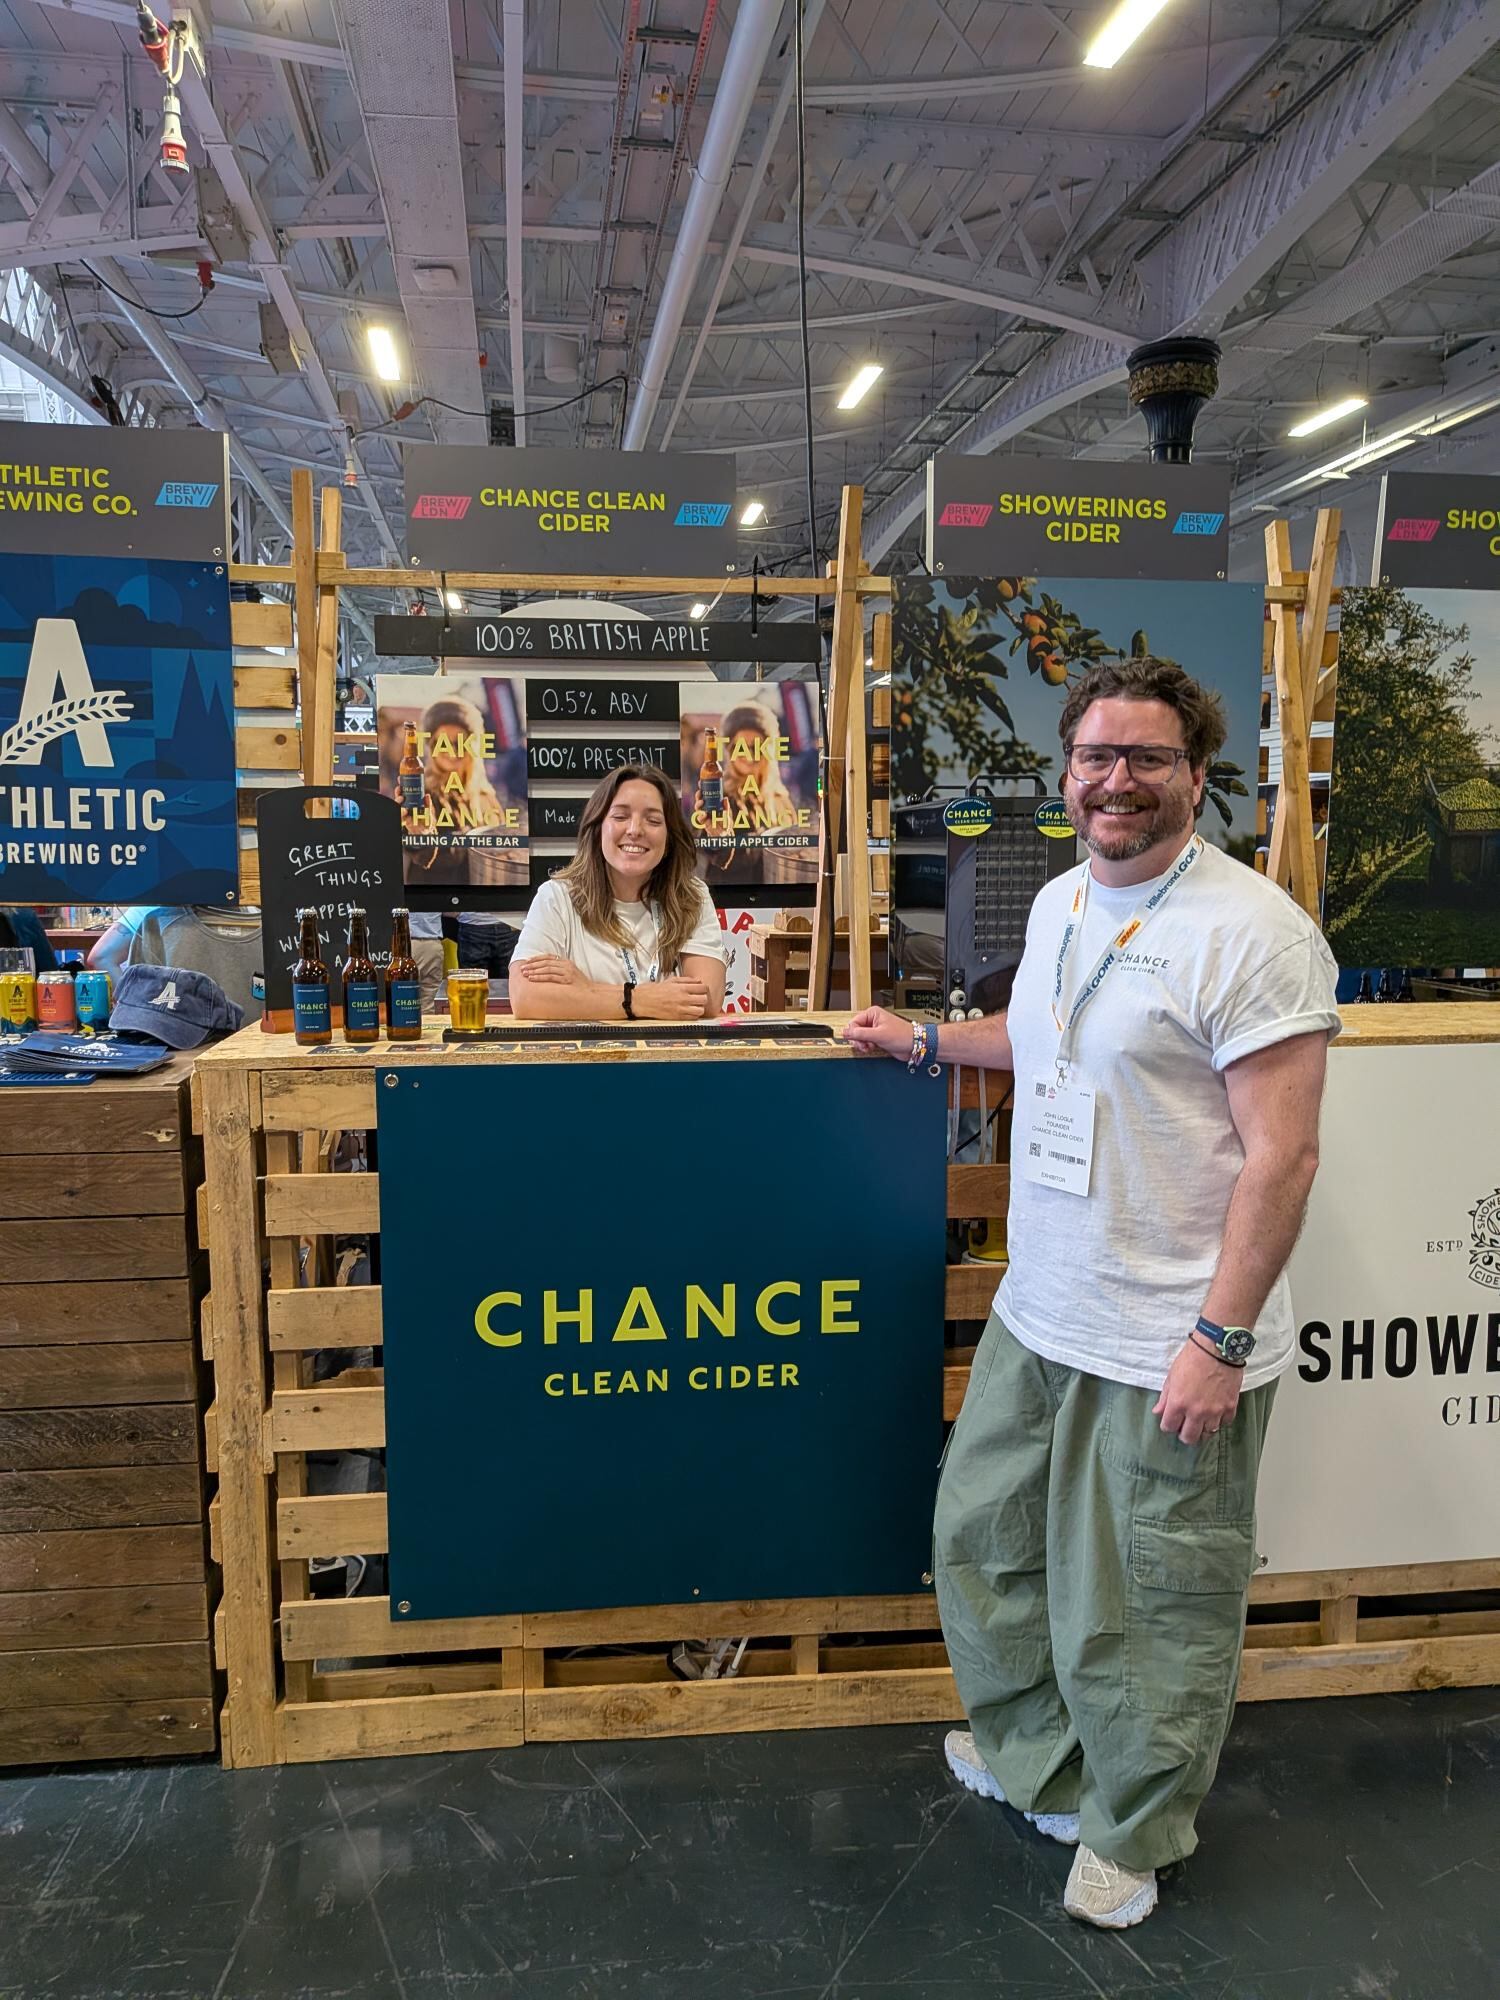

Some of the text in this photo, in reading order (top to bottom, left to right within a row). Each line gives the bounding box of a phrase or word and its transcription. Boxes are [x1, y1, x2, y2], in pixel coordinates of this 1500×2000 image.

[165, 484, 204, 495] BREW
[166, 495, 193, 504] LDN
[480, 488, 665, 511] CHANCE CLEAN
[92, 495, 138, 515] CO.
[421, 498, 457, 507] BREW
[422, 507, 448, 516] LDN
[684, 505, 717, 515] BREW
[949, 506, 980, 514] BREW
[999, 494, 1167, 520] SHOWERINGS
[538, 513, 610, 533] CIDER
[684, 514, 709, 524] LDN
[949, 515, 972, 524] LDN
[1181, 523, 1205, 532] LDN
[1182, 514, 1213, 524] BREW
[1446, 509, 1500, 531] SHO
[1046, 521, 1120, 543] CIDER
[476, 622, 711, 652] 100% BRITISH APPLE
[542, 688, 648, 715] 0.5% ABV
[415, 732, 497, 759] TAKE
[715, 736, 790, 761] TAKE
[530, 746, 666, 770] 100% PRESENT
[444, 771, 465, 794] A
[742, 775, 760, 796] A
[0, 786, 166, 832] HLETIC
[400, 807, 520, 828] HANCE
[544, 808, 576, 824] Made
[690, 808, 811, 829] CHANCE
[947, 809, 992, 819] CHANCE
[451, 836, 467, 846] AT
[469, 837, 492, 846] THE
[496, 837, 519, 847] BAR
[740, 837, 774, 847] APPLE
[777, 836, 809, 846] CIDER
[0, 842, 100, 865] REWING
[288, 843, 353, 867] GREAT
[315, 869, 383, 888] THINGS
[1145, 872, 1181, 911] Hillebrand
[1091, 953, 1116, 989] GORI
[296, 1003, 328, 1011] CHANCE
[1031, 1125, 1051, 1135] CHANCE
[474, 1279, 861, 1348] CHANCE
[544, 1363, 801, 1397] CLEAN CIDER
